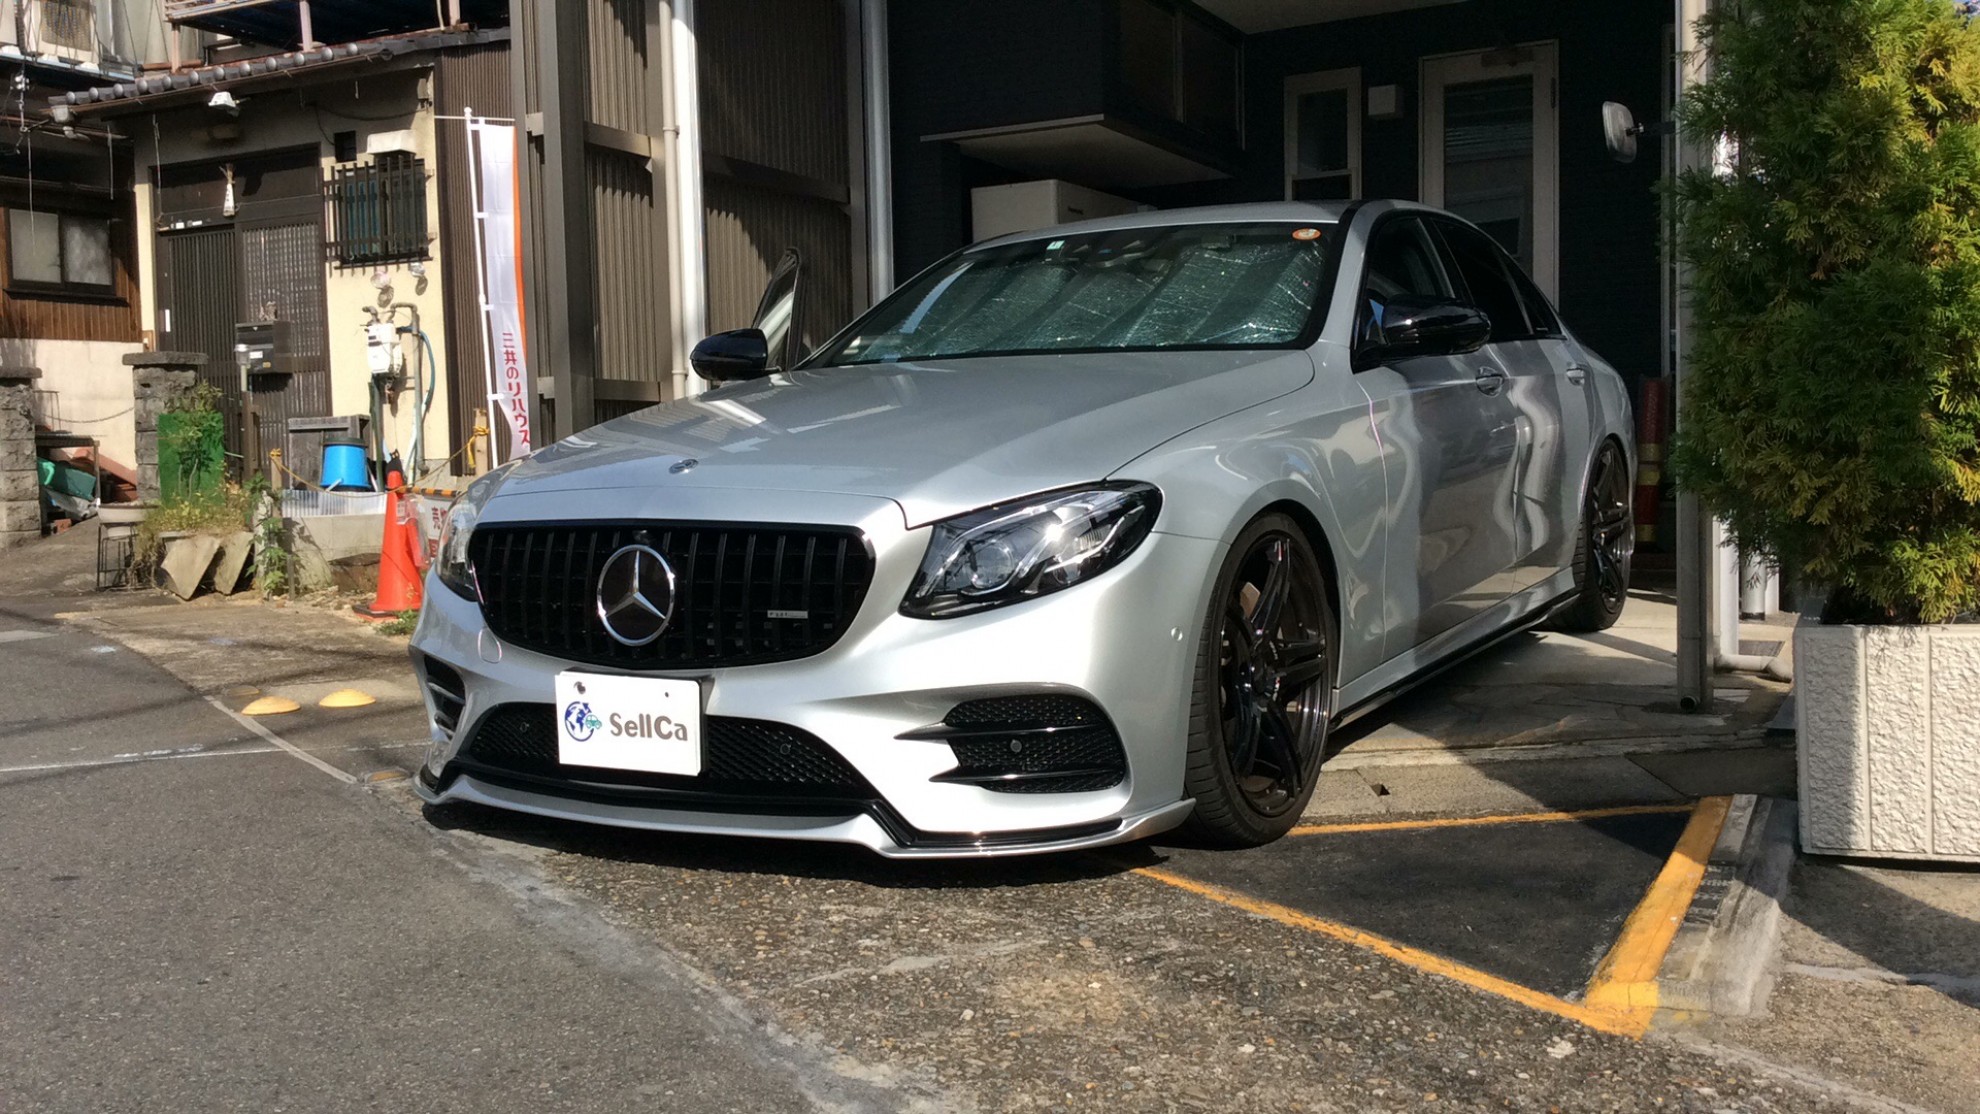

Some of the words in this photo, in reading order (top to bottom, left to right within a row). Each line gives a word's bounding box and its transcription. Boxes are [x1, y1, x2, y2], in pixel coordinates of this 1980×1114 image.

[502, 332, 530, 444] 三井のリハウス
[609, 712, 688, 741] SellCa
